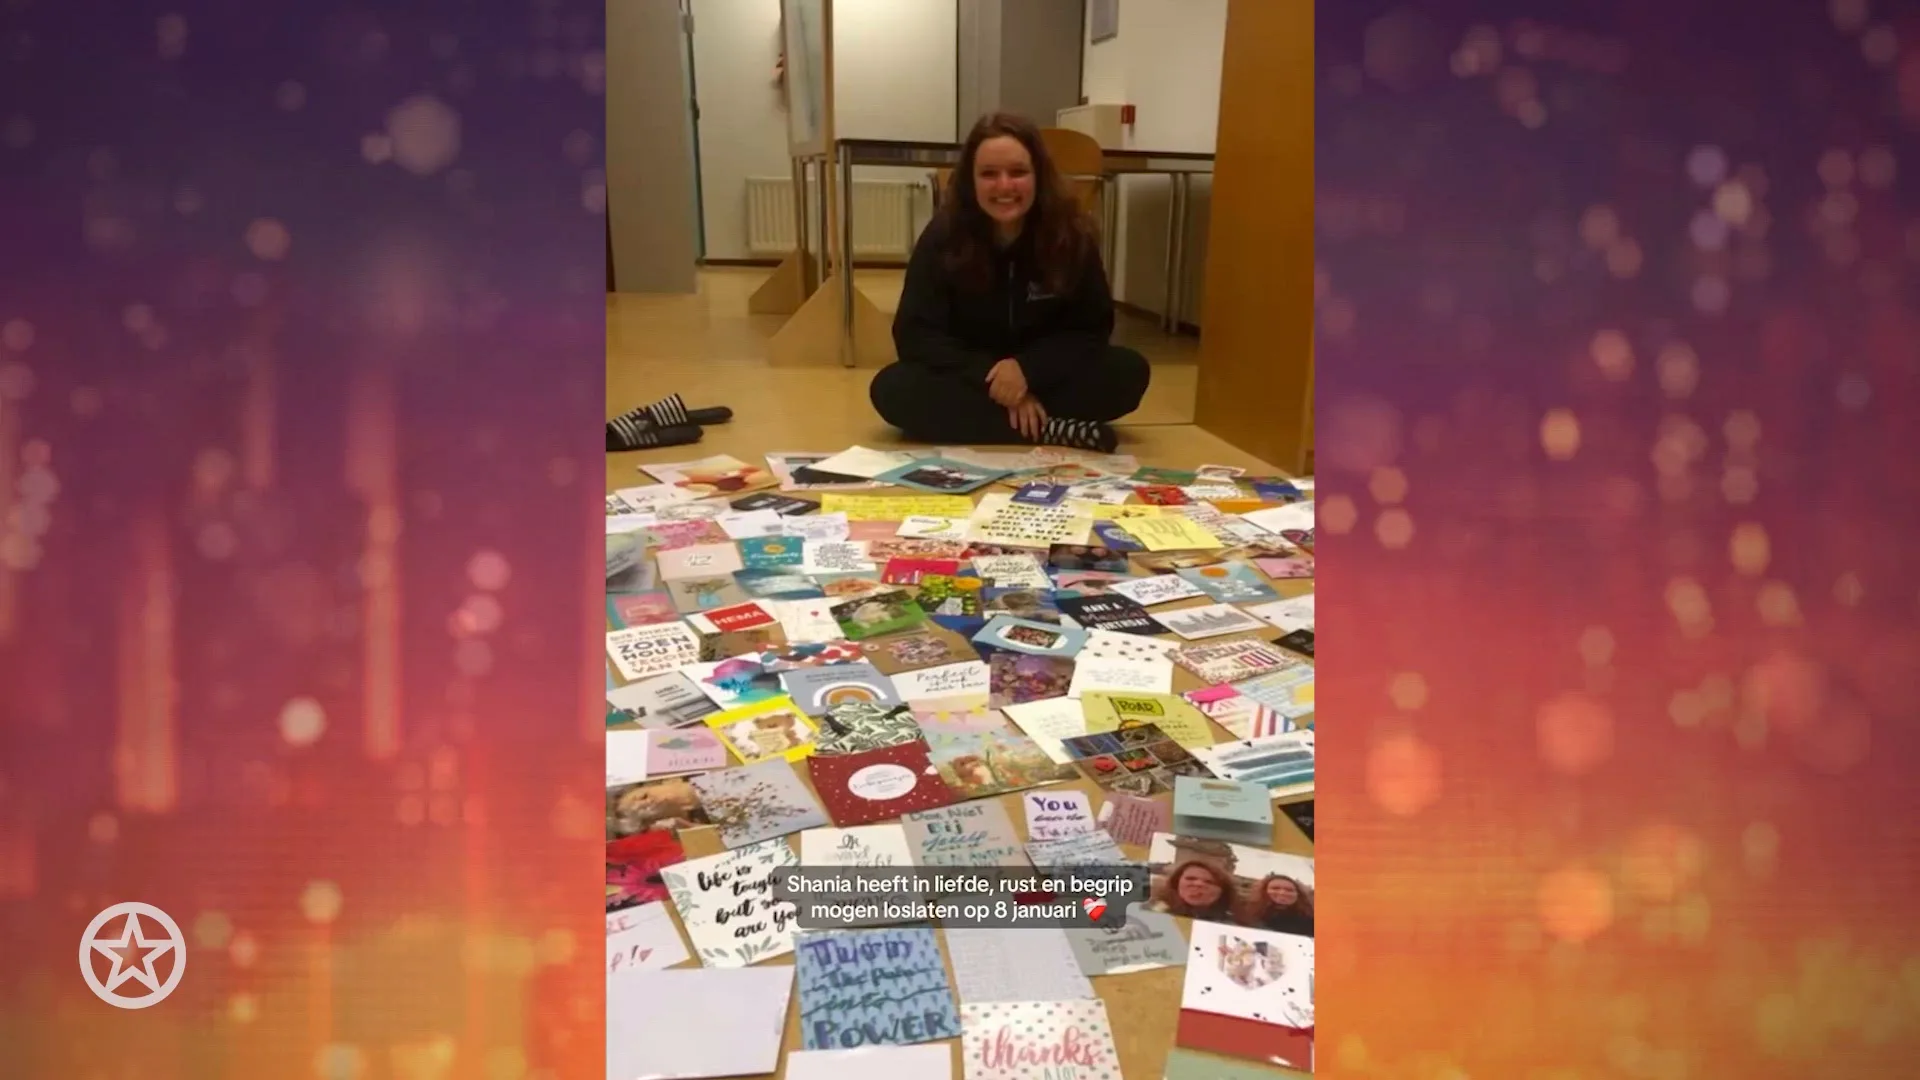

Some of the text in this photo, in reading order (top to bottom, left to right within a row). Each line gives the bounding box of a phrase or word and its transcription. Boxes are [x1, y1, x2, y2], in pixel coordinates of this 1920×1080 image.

[715, 609, 765, 627] HEMA
[618, 635, 690, 653] ZOEN
[622, 647, 669, 661] HOU
[632, 662, 672, 674] VAN
[736, 865, 752, 876] is
[729, 871, 782, 897] tough
[715, 897, 757, 925] but
[734, 921, 768, 938] are
[982, 1024, 1101, 1069] thanks
